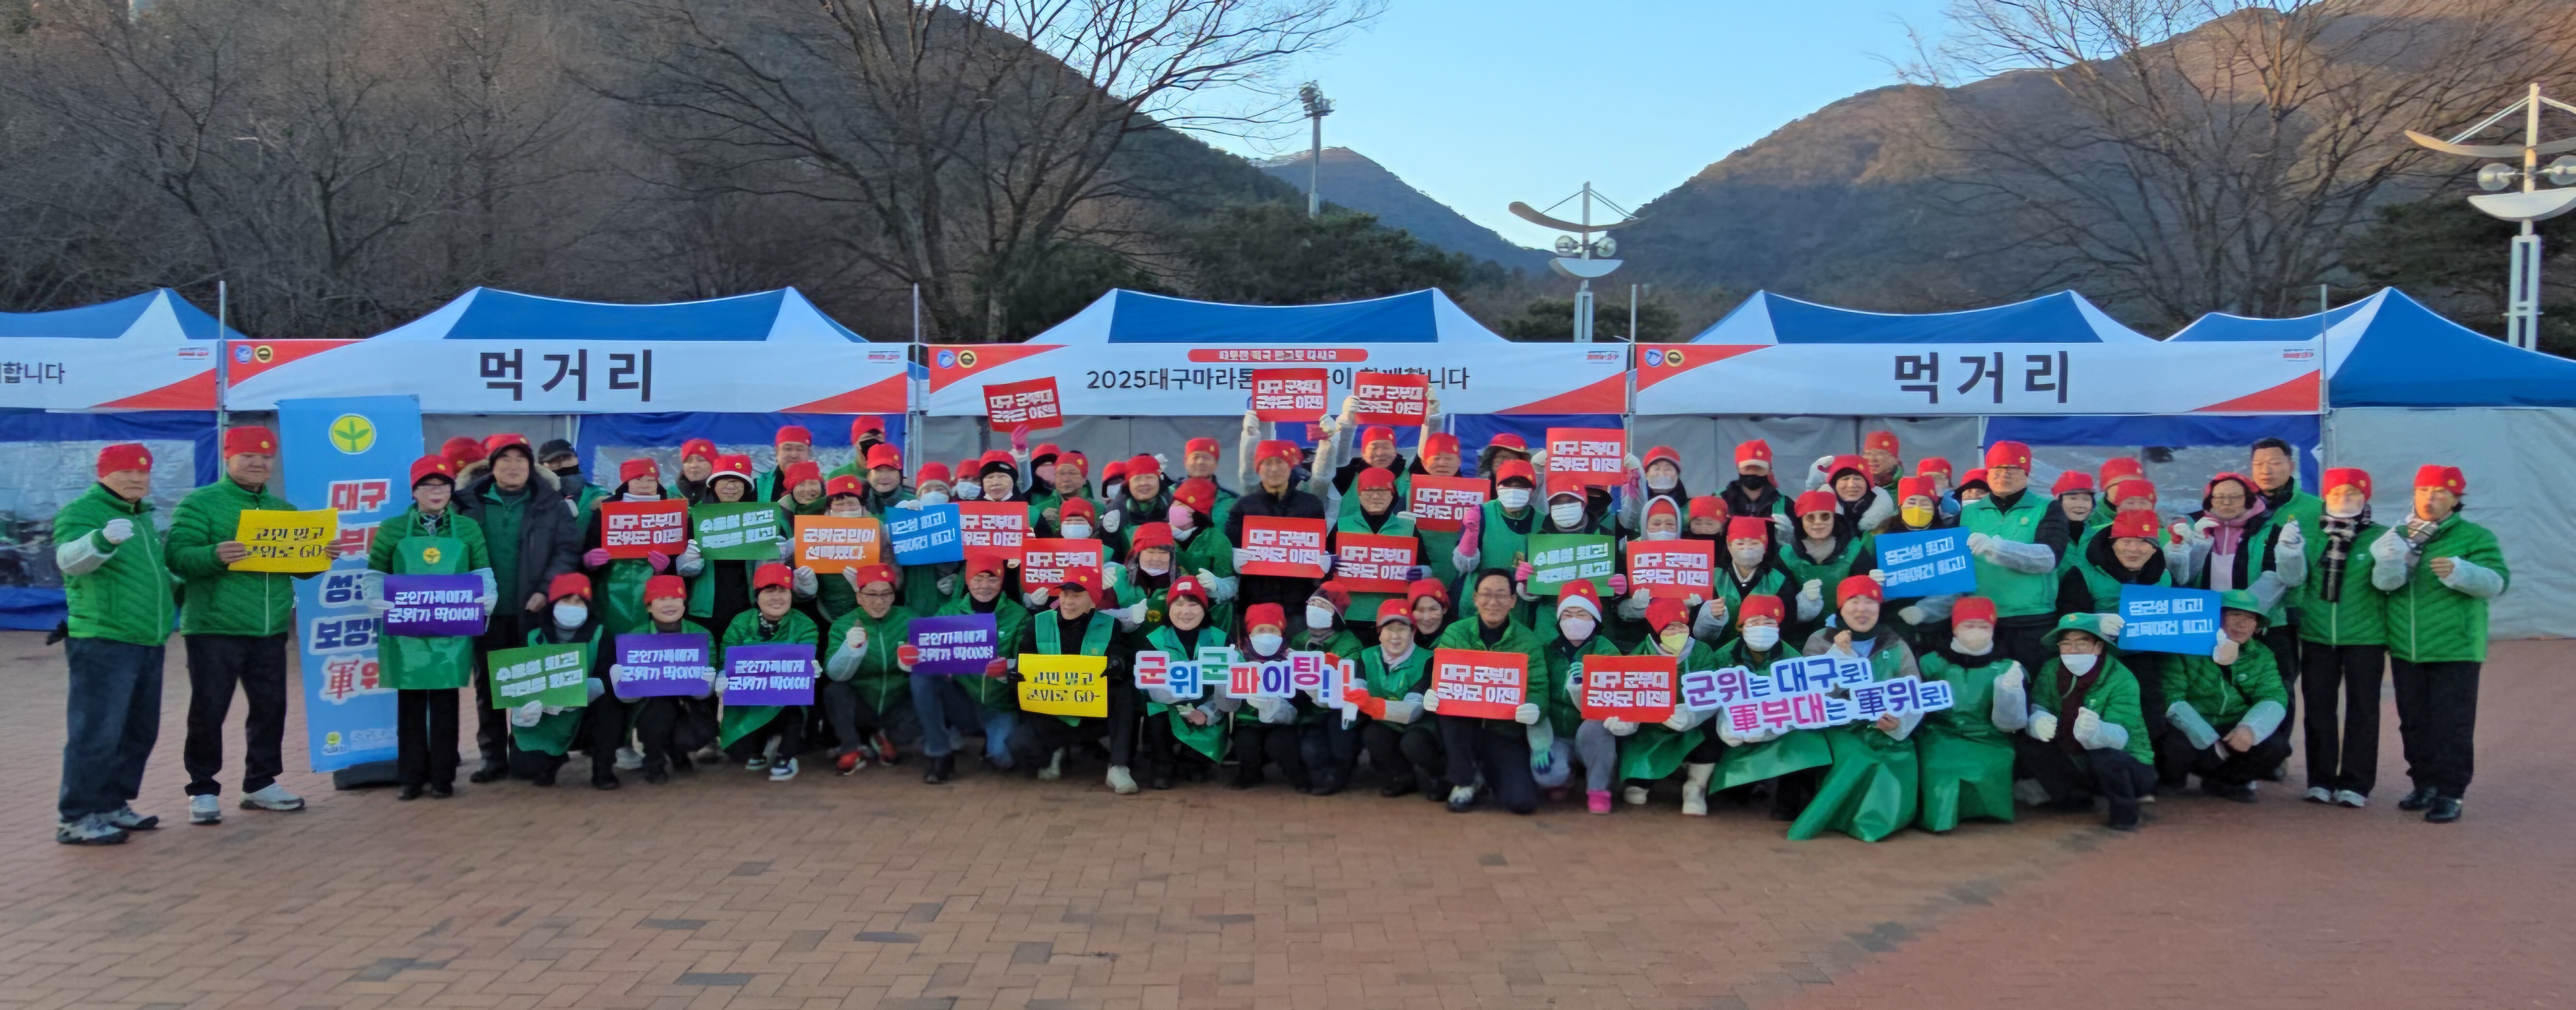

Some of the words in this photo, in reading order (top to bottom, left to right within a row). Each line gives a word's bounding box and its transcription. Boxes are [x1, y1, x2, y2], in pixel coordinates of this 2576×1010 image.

[0, 362, 65, 383] 합니다
[480, 348, 651, 402] 먹거리
[1895, 350, 2068, 403] 먹거리
[331, 482, 387, 511] 대구
[315, 618, 380, 649] 보장
[1686, 669, 1770, 707] 군위는
[1775, 658, 1869, 693] 대구로!
[1729, 693, 1846, 732] 軍부대는
[1855, 679, 1949, 716] 軍위로!
